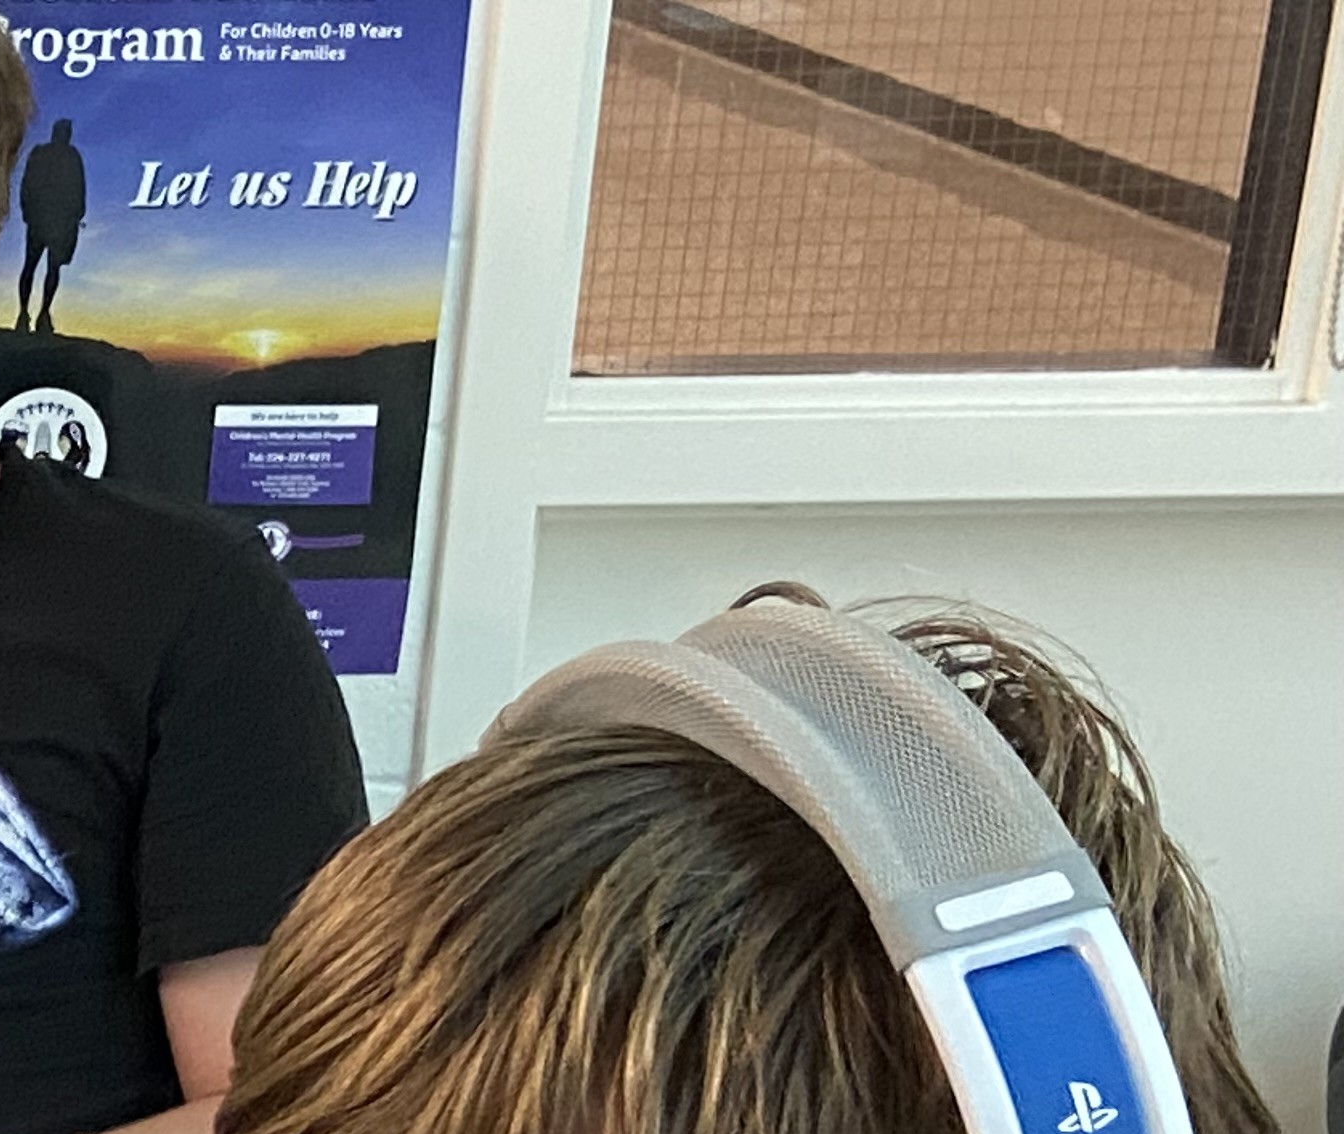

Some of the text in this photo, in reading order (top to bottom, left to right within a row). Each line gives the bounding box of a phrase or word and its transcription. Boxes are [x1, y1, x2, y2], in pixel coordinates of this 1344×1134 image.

[220, 22, 403, 39] For Children 0-18 Years
[218, 45, 346, 61] & Their Families
[129, 160, 419, 220] Let us Help
